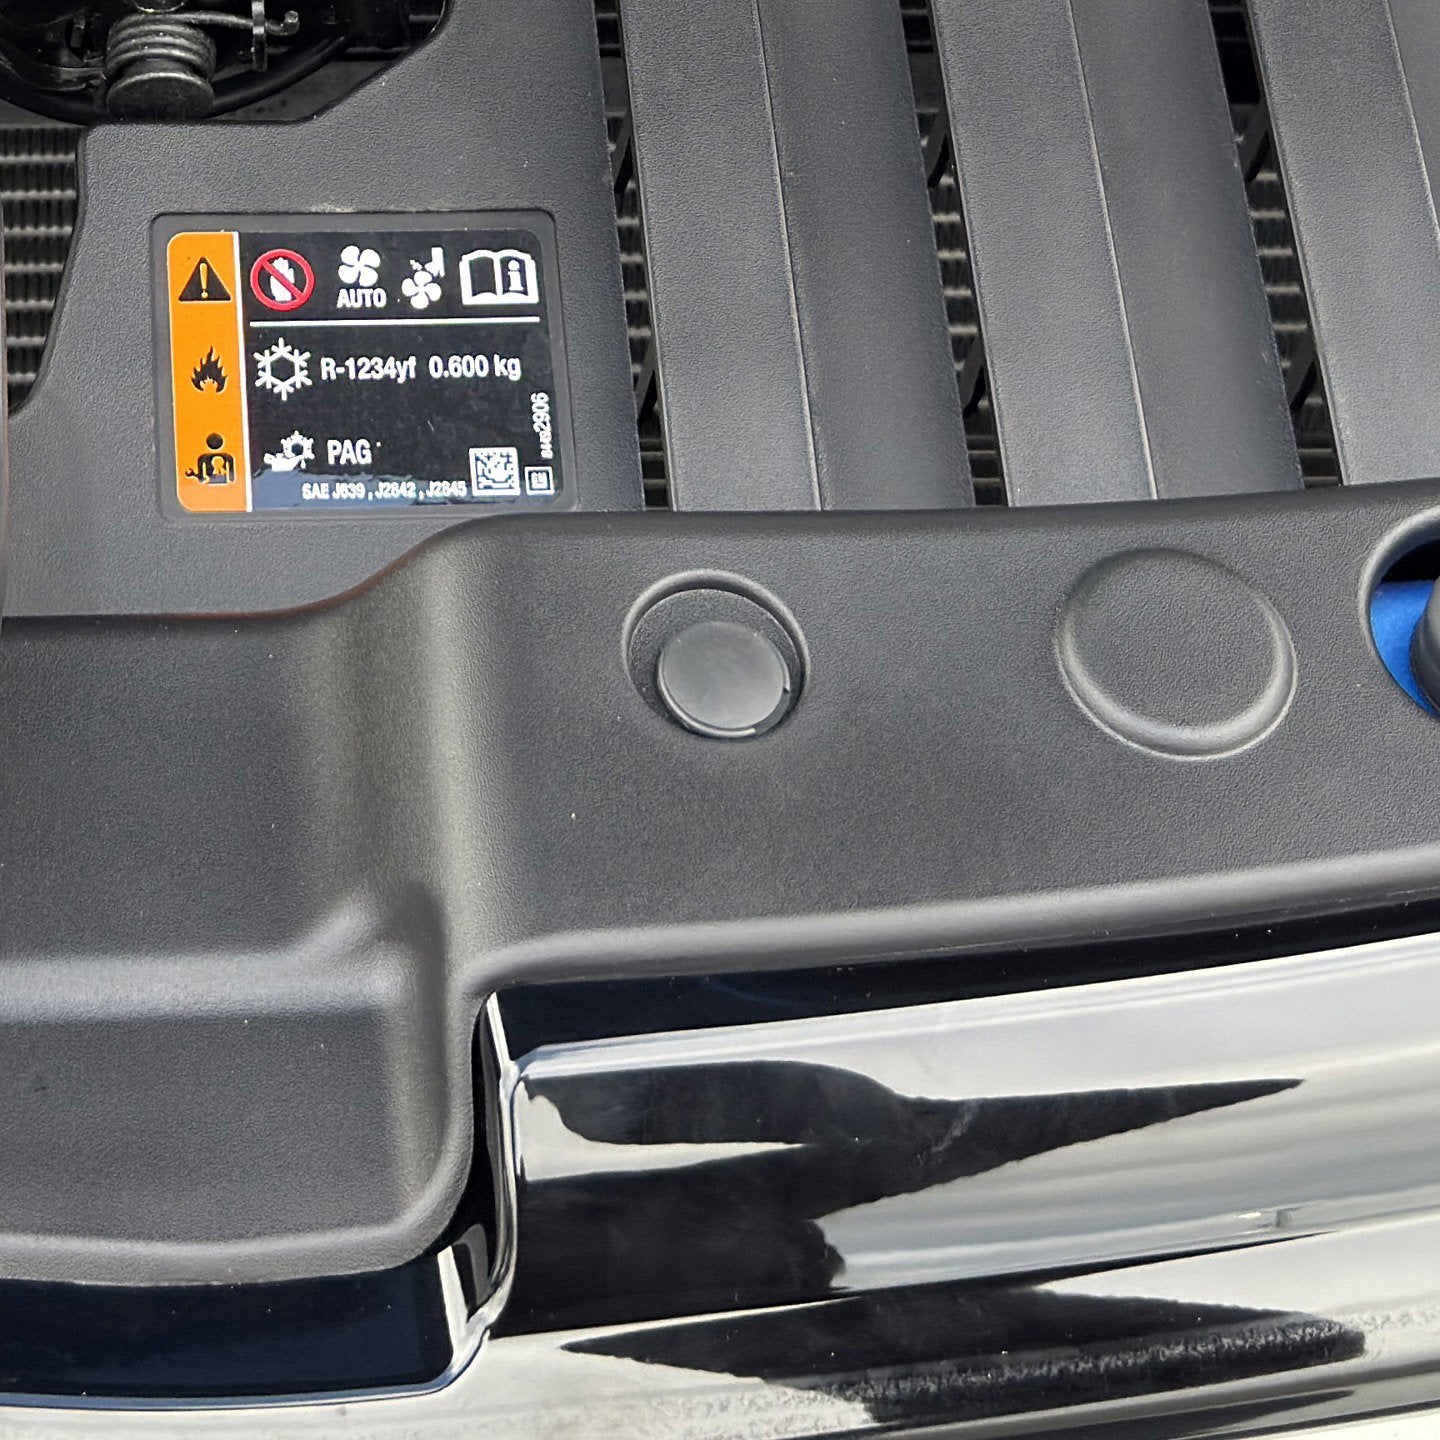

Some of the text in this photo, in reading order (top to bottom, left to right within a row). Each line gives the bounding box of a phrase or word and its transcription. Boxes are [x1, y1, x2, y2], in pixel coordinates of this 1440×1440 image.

[337, 288, 387, 309] AUTO
[320, 353, 522, 384] R-1234yf 0.600 kg
[327, 438, 373, 466] PAG
[302, 483, 330, 500] SAE
